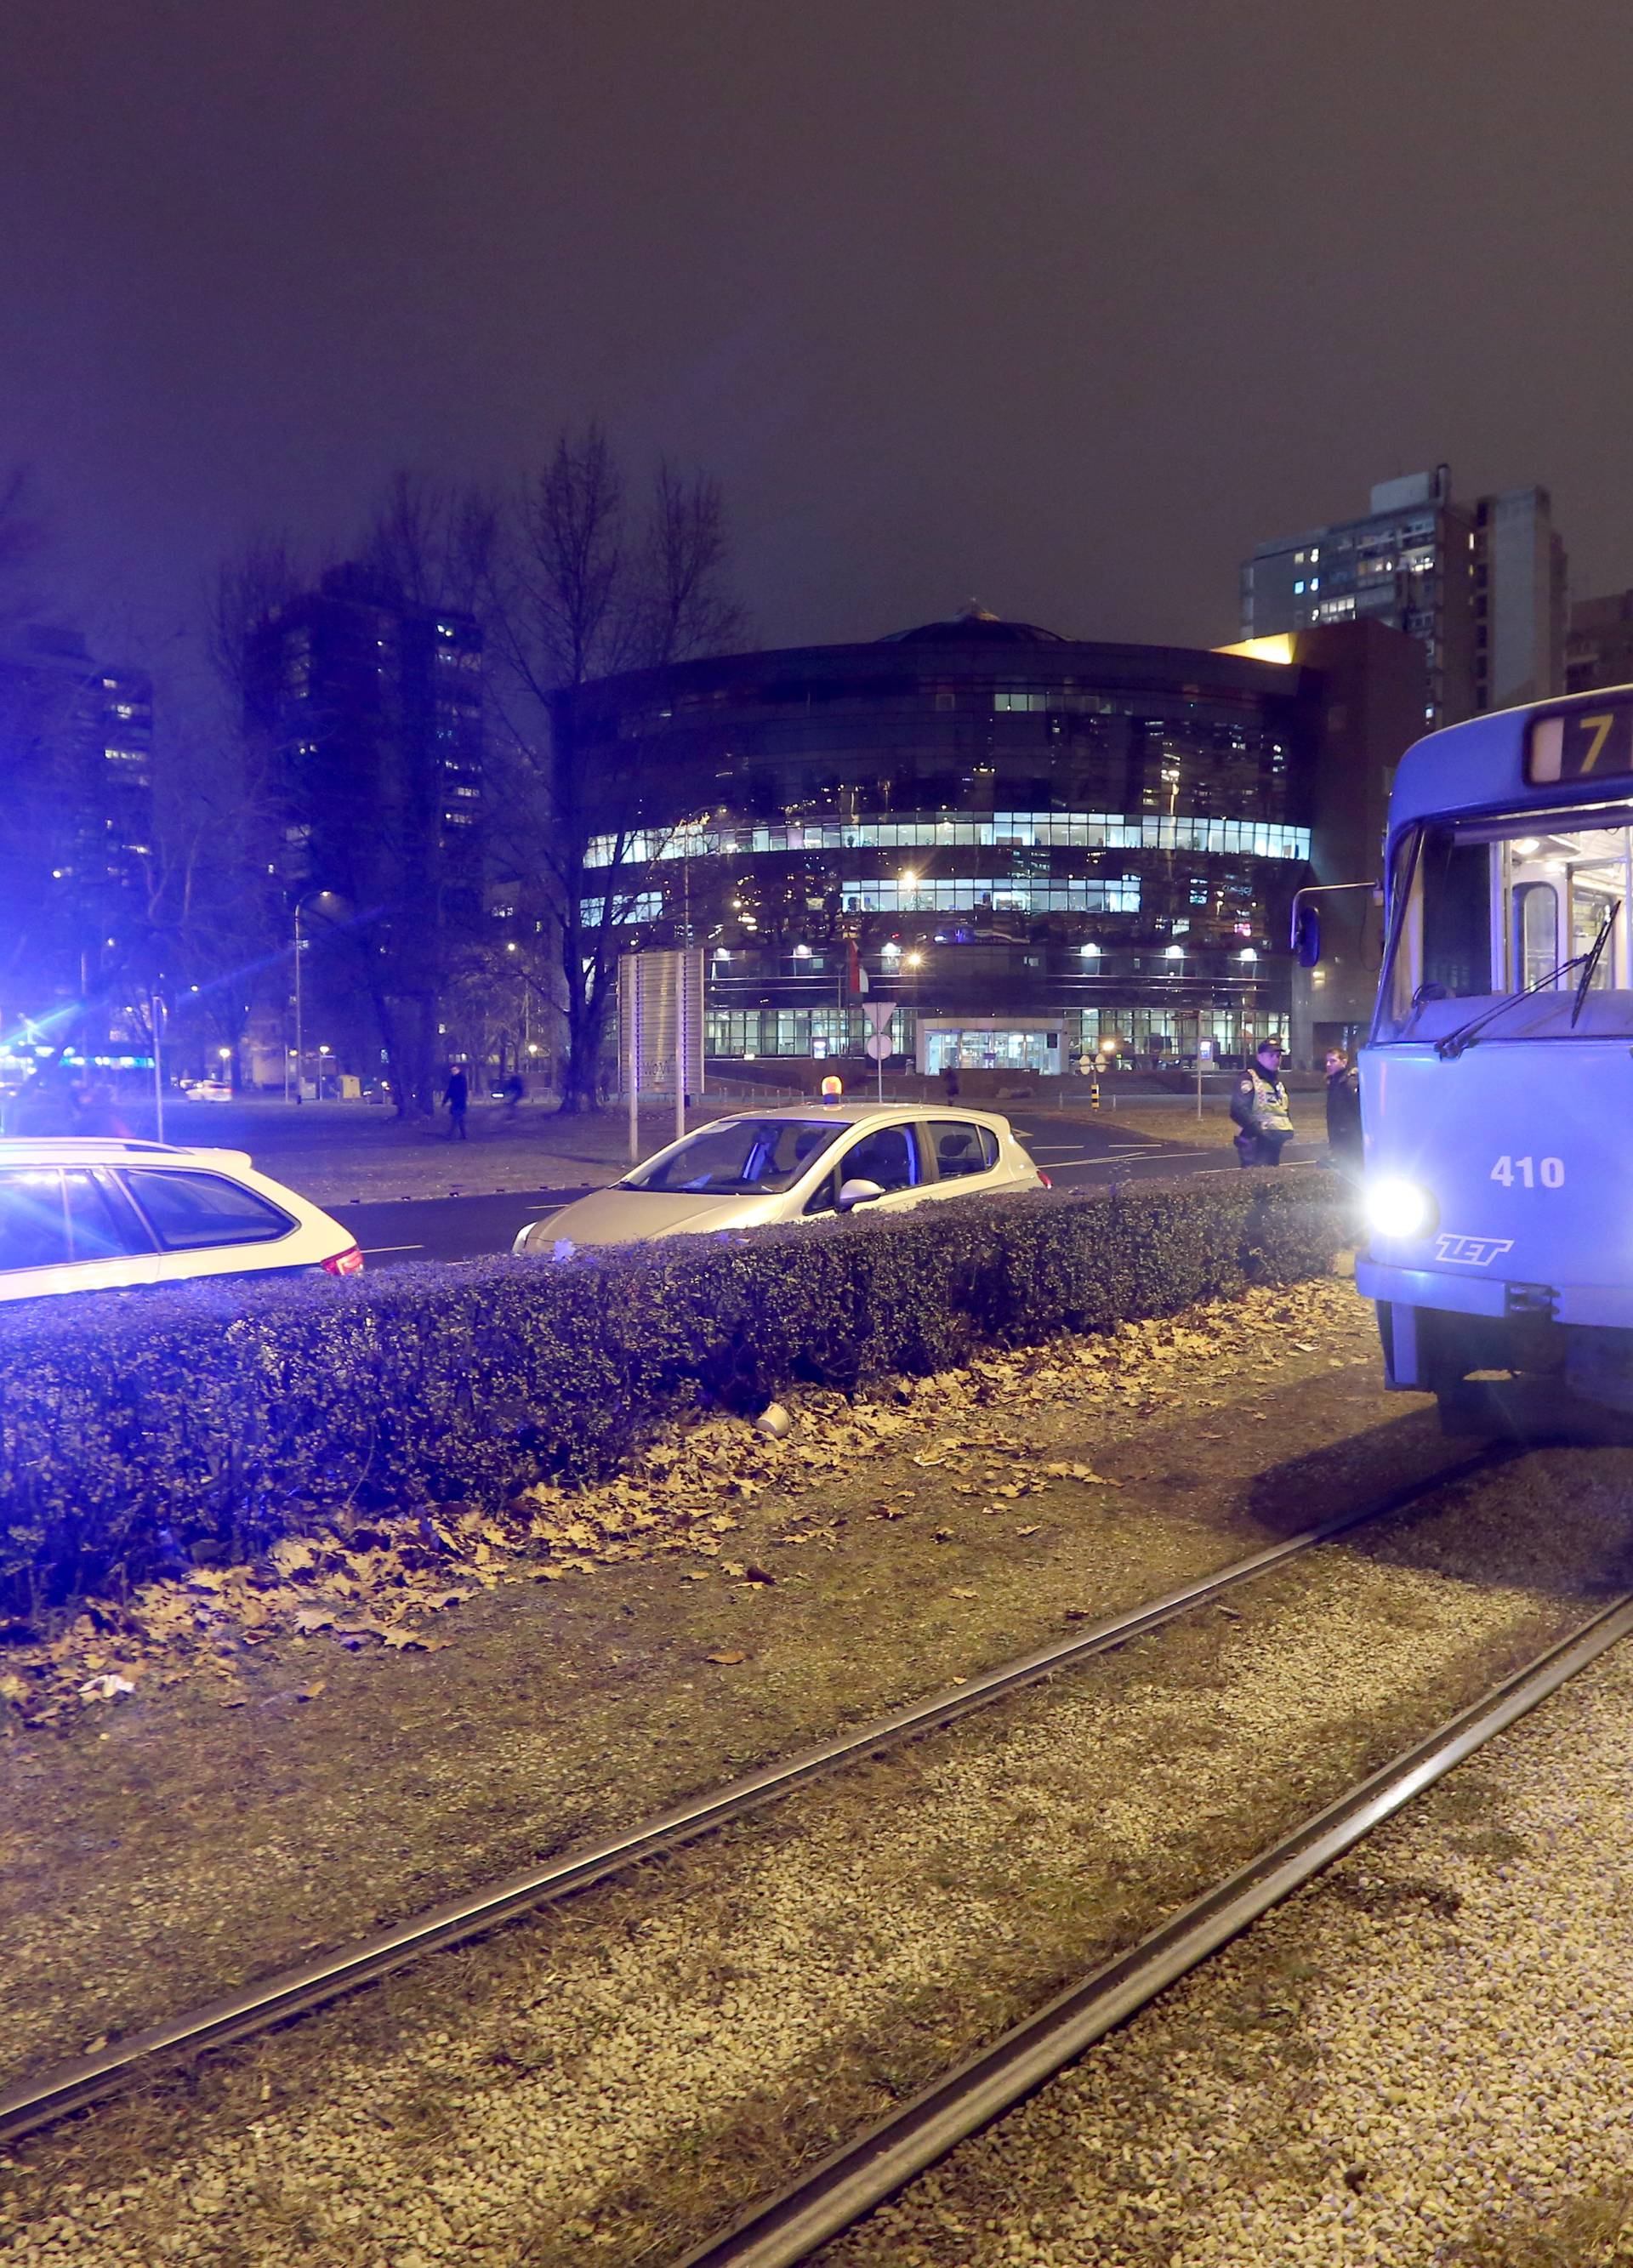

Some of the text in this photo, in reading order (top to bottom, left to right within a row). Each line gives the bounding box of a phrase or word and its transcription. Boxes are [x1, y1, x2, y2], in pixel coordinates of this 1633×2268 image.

[1580, 713, 1613, 773] 7
[1490, 1156, 1565, 1188] 410
[1436, 1234, 1514, 1266] ZET
